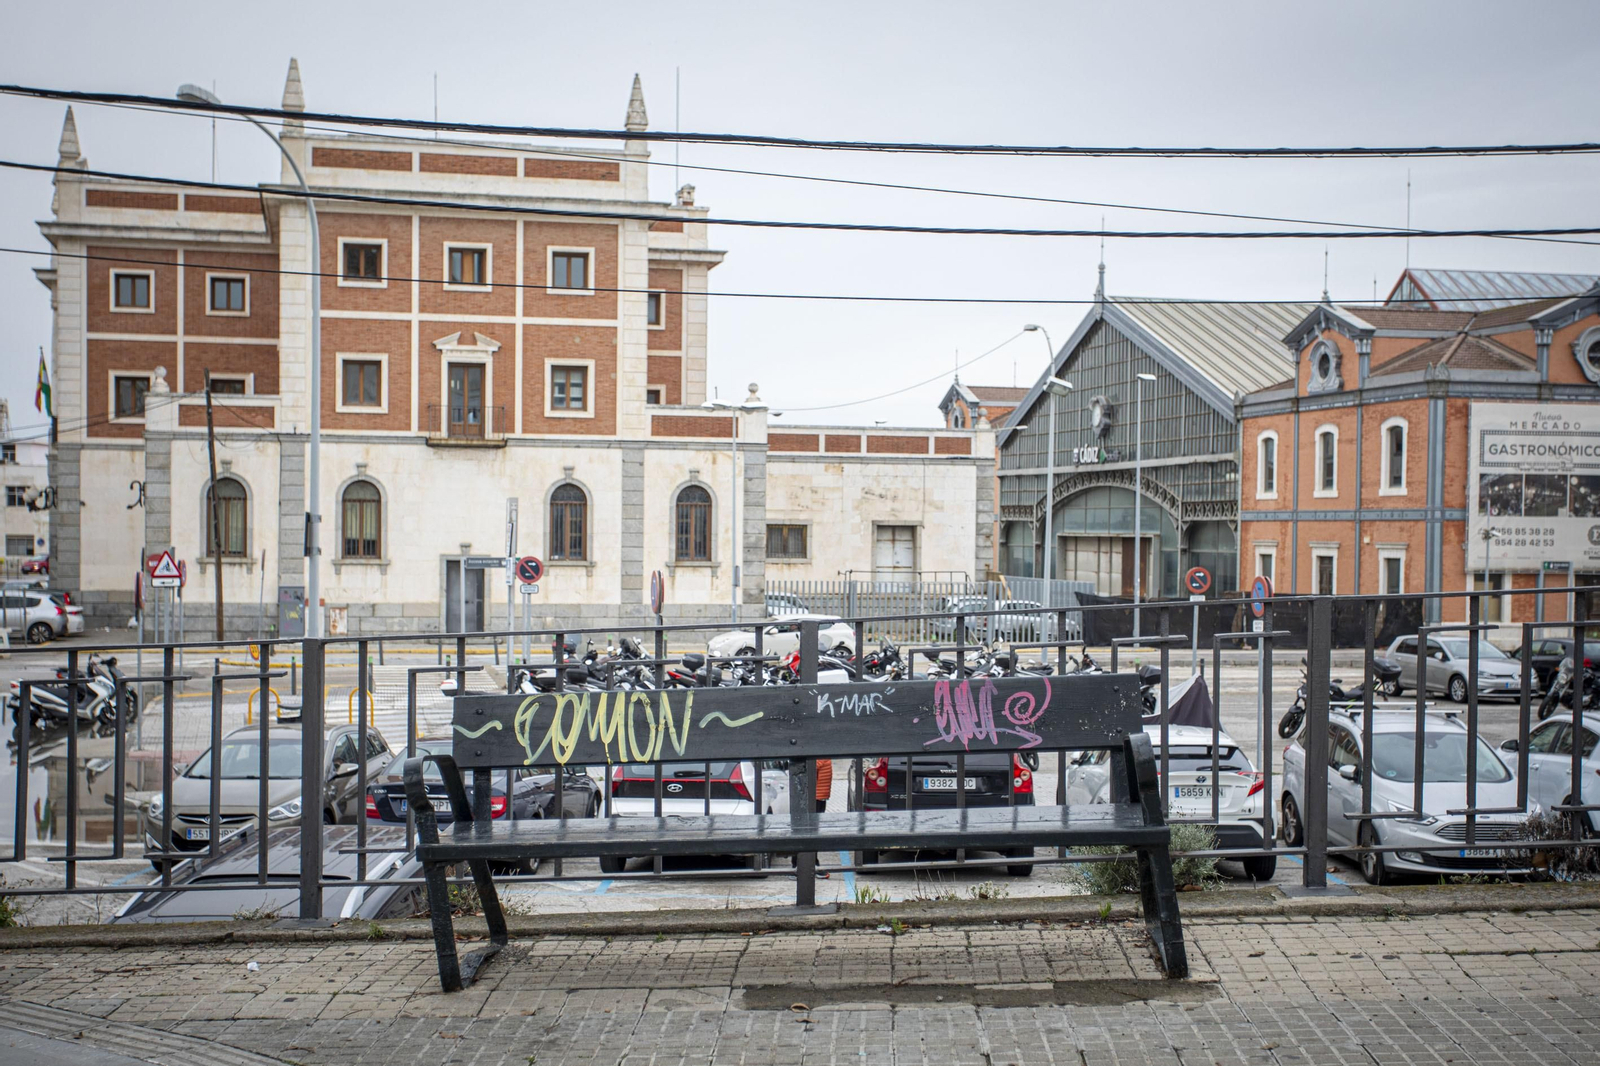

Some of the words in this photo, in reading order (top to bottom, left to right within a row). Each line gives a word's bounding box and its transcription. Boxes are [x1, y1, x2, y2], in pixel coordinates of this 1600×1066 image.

[1533, 411, 1562, 421] Nuevo
[1509, 421, 1581, 431] MERCADO
[1080, 443, 1099, 463] CÁDIZ
[1489, 441, 1600, 457] GASTRONÓMICO
[1542, 528, 1555, 536] 28
[1494, 538, 1513, 547] 954
[1528, 539, 1541, 547] 42
[1542, 539, 1555, 547] 53
[930, 779, 953, 788] 9382
[1180, 788, 1204, 797] 5859
[1206, 788, 1224, 797] KN
